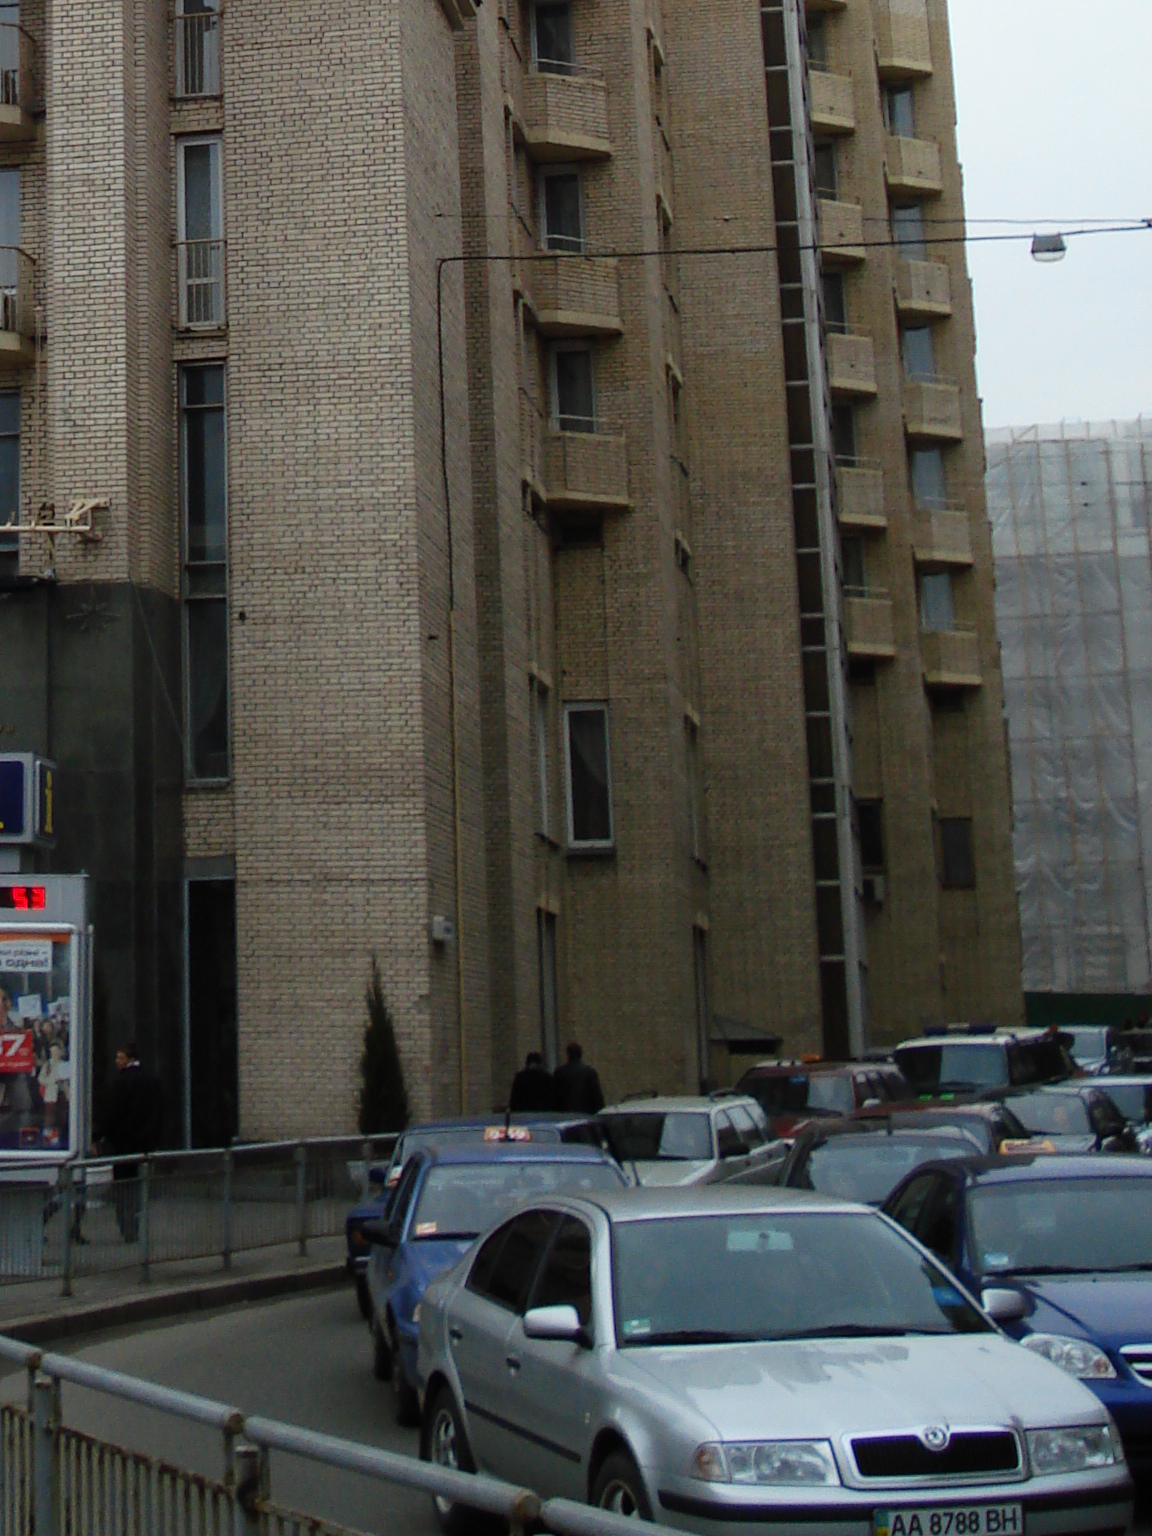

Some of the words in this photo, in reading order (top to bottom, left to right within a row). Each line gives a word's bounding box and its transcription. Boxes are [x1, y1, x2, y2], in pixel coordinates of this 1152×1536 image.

[892, 1514, 923, 1536] AA
[930, 1511, 980, 1535] 8788
[986, 1507, 1017, 1532] BH
